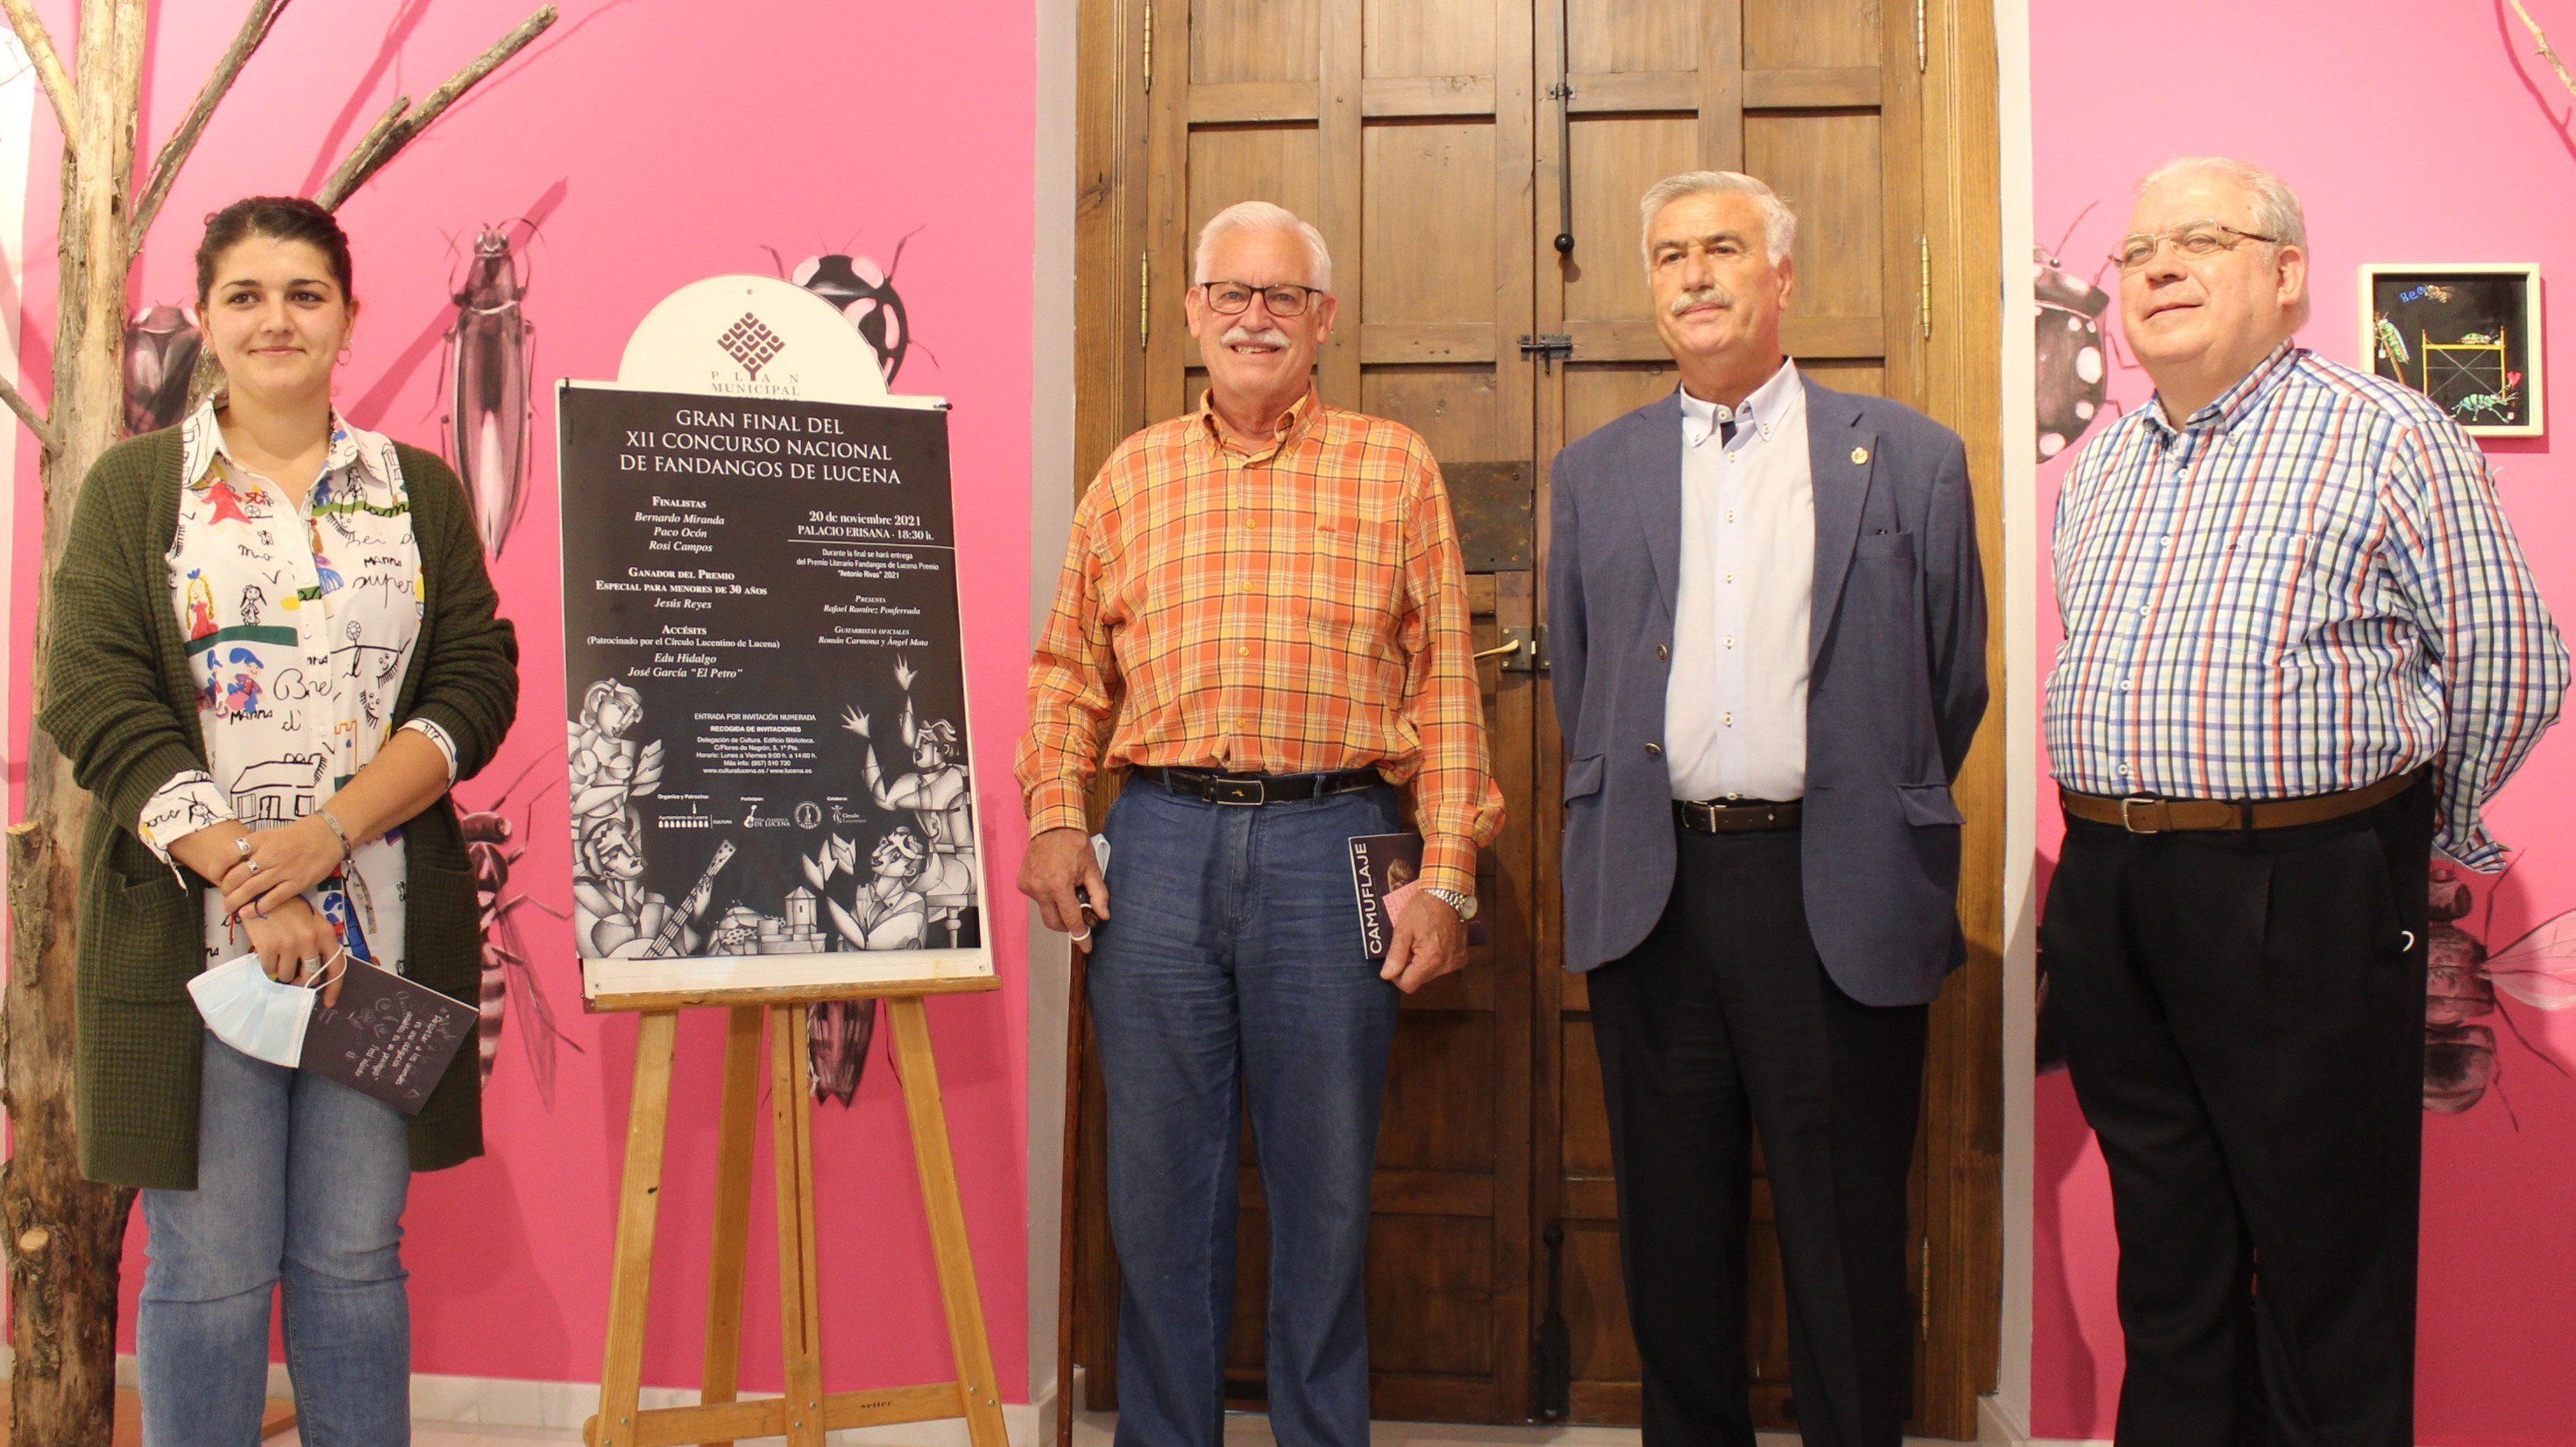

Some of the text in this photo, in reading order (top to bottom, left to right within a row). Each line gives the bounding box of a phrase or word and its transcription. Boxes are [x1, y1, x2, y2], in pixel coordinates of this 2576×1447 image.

[712, 383, 799, 396] MUNICIPAL
[676, 409, 843, 435] GRAN FINAL DEL
[626, 431, 891, 461] XII CONCURSO NACIONAL
[621, 454, 900, 486] DE FANDANGOS DE LUCENA
[635, 512, 725, 525] Bernardo Miranda
[809, 510, 920, 526] 20 de noviembre 2021
[654, 527, 707, 538] Paco Ocón
[798, 525, 934, 541] PALACIO ERISANA 18:30 h.
[649, 540, 713, 554] Rosi Campos
[822, 548, 846, 557] Durante
[854, 550, 866, 558] final
[876, 550, 890, 559] hará
[891, 552, 913, 561] entrega
[855, 560, 887, 570] Fandangos
[919, 562, 940, 571] Premio
[729, 585, 742, 595] 30
[654, 598, 712, 611] Jesús Reyes
[823, 604, 920, 616] Rafael Ramírez Ponferrada
[586, 636, 638, 646] (Patrocinado
[640, 639, 654, 648] por
[664, 637, 694, 647] Círculo
[696, 639, 735, 648] Lucentino
[737, 639, 747, 648] de
[749, 639, 780, 649] Lucena)
[818, 635, 844, 644] Román
[846, 636, 879, 645] Carmona
[887, 635, 908, 647] Ángel
[909, 638, 929, 647] Mata
[654, 653, 717, 666] Edu Hidalgo
[628, 667, 650, 677] José
[653, 668, 687, 677] García
[479, 842, 506, 954] CAMUFLAJE
